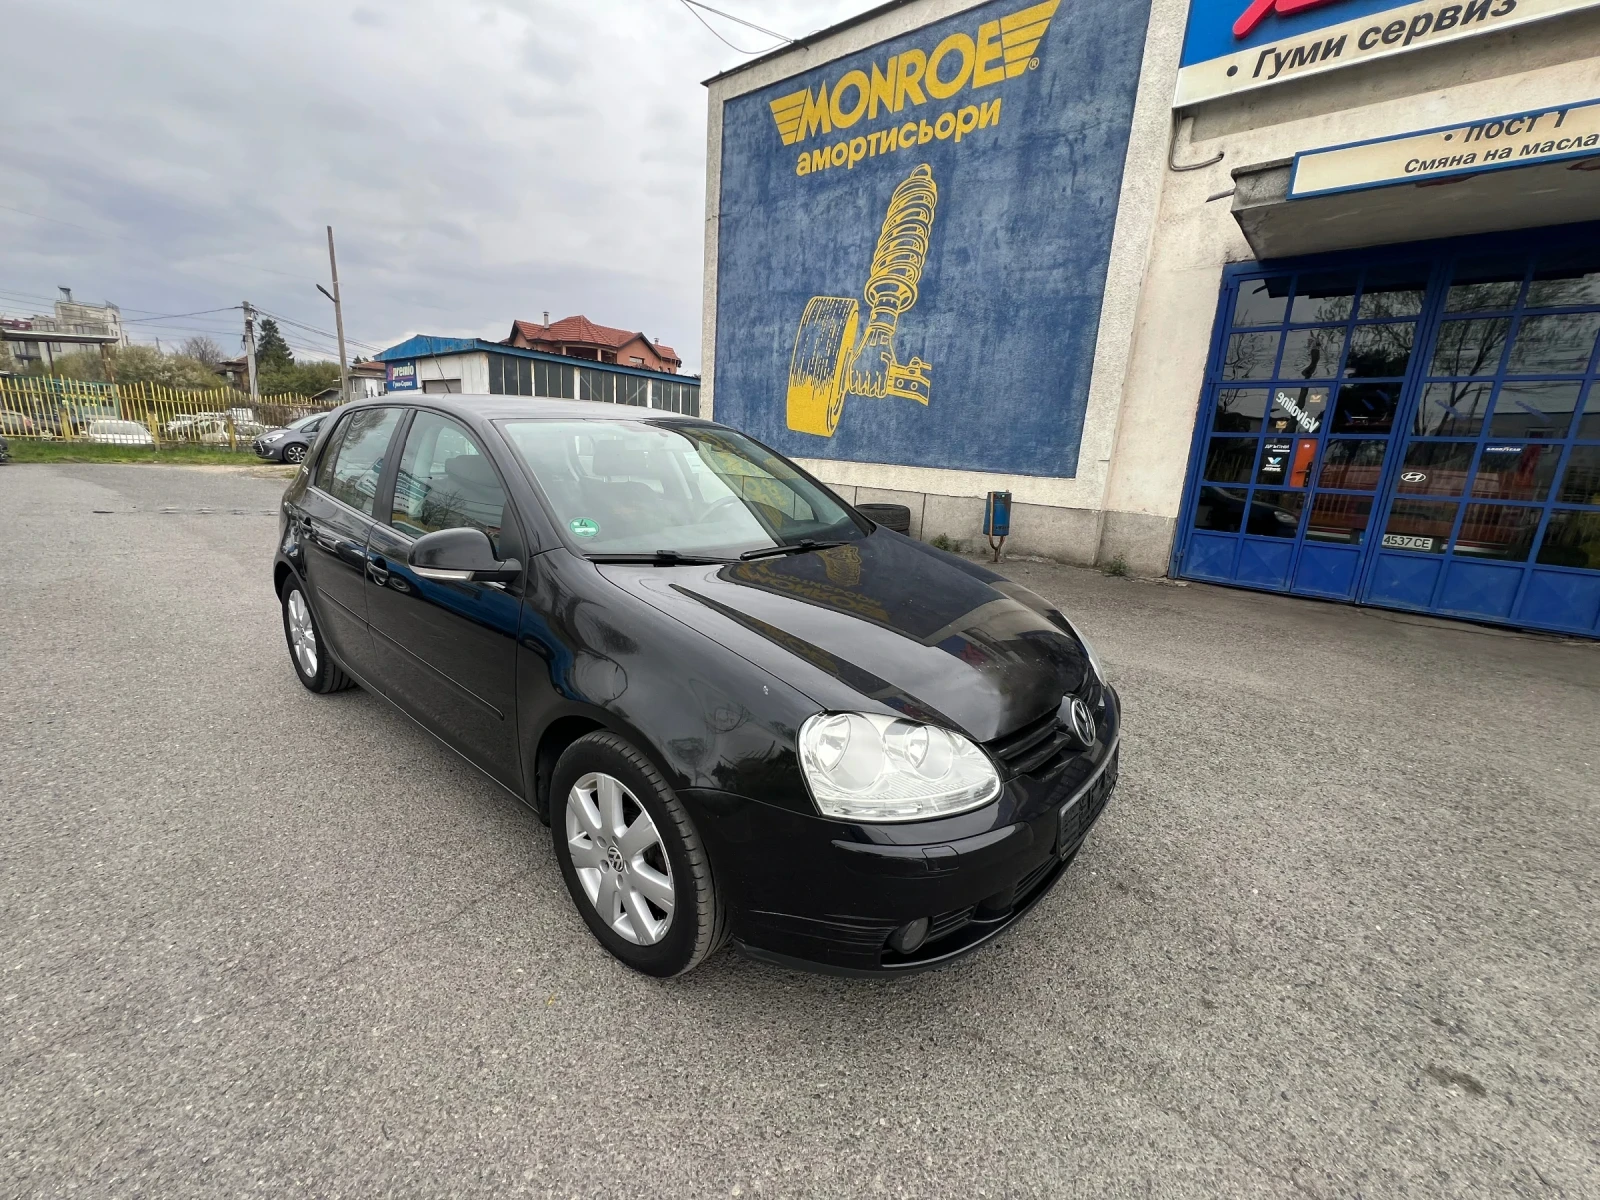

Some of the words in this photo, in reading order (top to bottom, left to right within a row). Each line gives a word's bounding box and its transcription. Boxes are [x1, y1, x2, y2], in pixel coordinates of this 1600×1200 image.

[1252, 34, 1349, 80] Гуми
[1358, 0, 1517, 50] сервиз
[797, 20, 1006, 142] MONROE
[796, 98, 1002, 177] амортисьори
[1404, 152, 1477, 173] Смяна
[1483, 147, 1513, 162] на
[1519, 133, 1600, 157] масла
[392, 362, 414, 380] premio
[1383, 535, 1413, 546] 4537
[1414, 538, 1431, 548] CE
